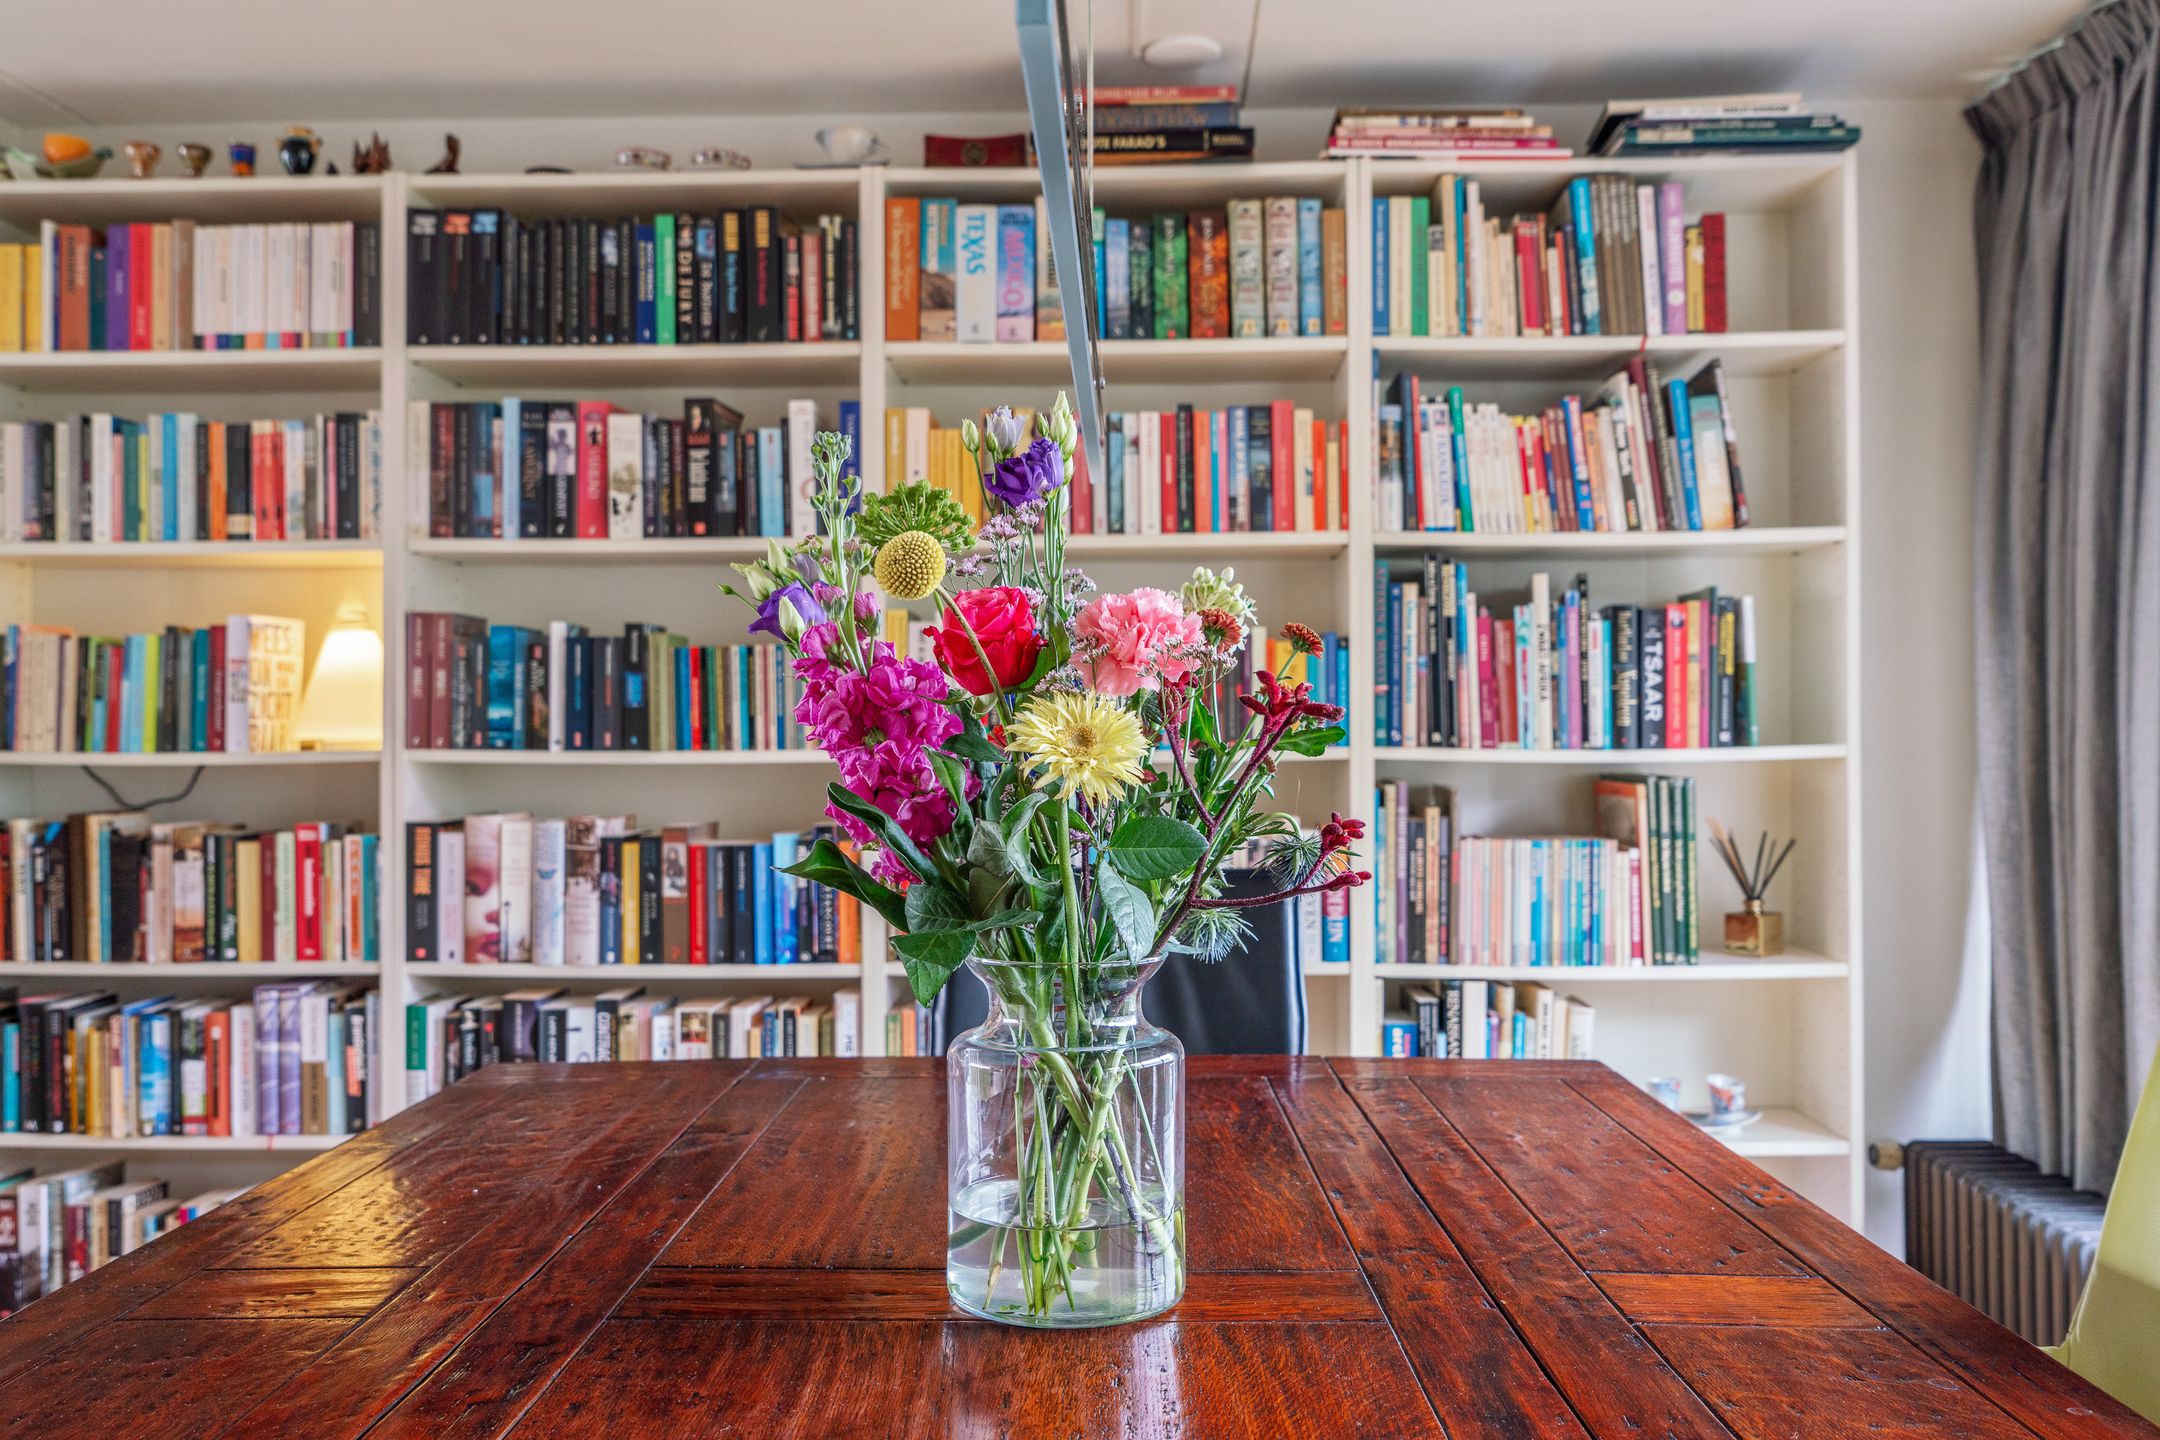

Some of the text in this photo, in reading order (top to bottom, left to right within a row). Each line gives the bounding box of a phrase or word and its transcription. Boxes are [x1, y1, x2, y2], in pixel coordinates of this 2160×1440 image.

[962, 214, 986, 275] TEXAS
[679, 278, 693, 324] JURY
[1615, 423, 1632, 477] New York
[1644, 641, 1663, 722] TSAAR
